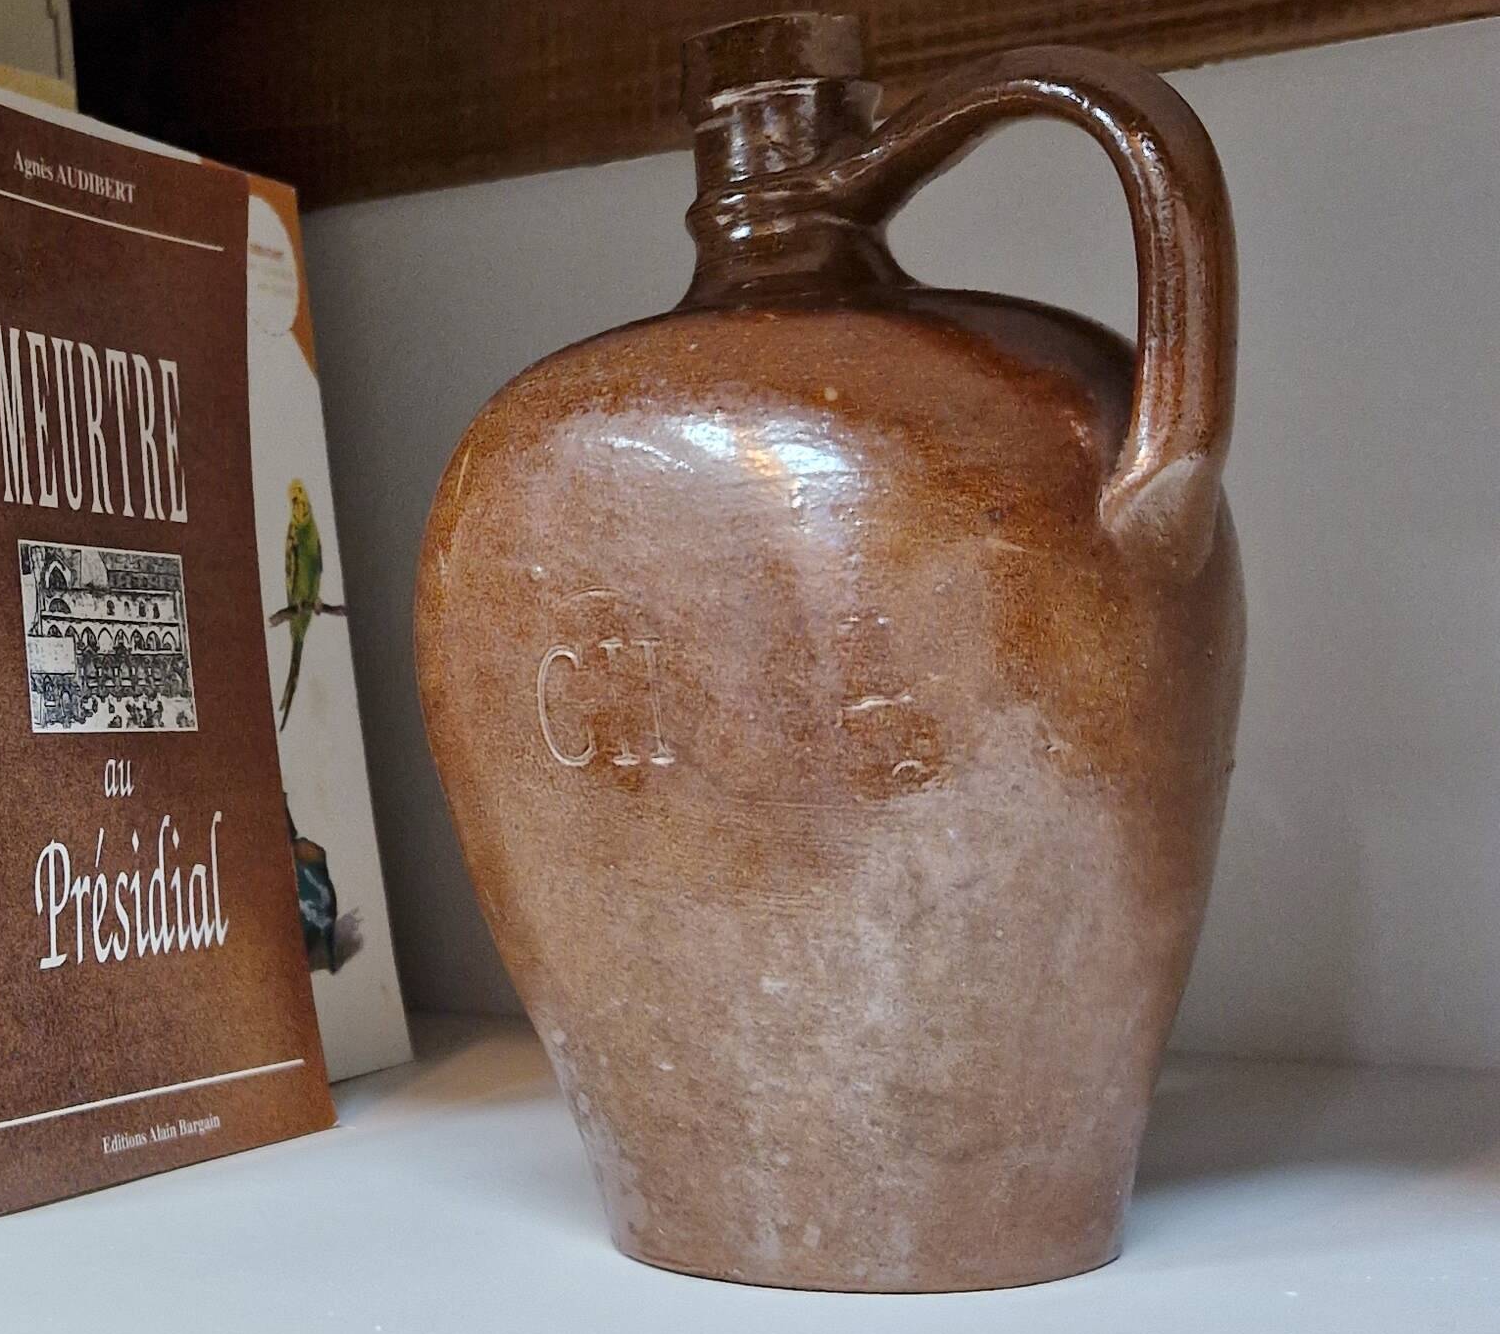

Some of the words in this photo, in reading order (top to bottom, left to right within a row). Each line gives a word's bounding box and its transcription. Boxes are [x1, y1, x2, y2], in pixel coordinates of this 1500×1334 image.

[13, 149, 53, 181] Agnès
[55, 165, 136, 204] AUDIBERT
[104, 757, 134, 798] au
[34, 810, 229, 970] Présidial
[101, 1131, 148, 1154] Editions
[148, 1123, 177, 1142] Alain
[178, 1112, 220, 1136] Bargain
